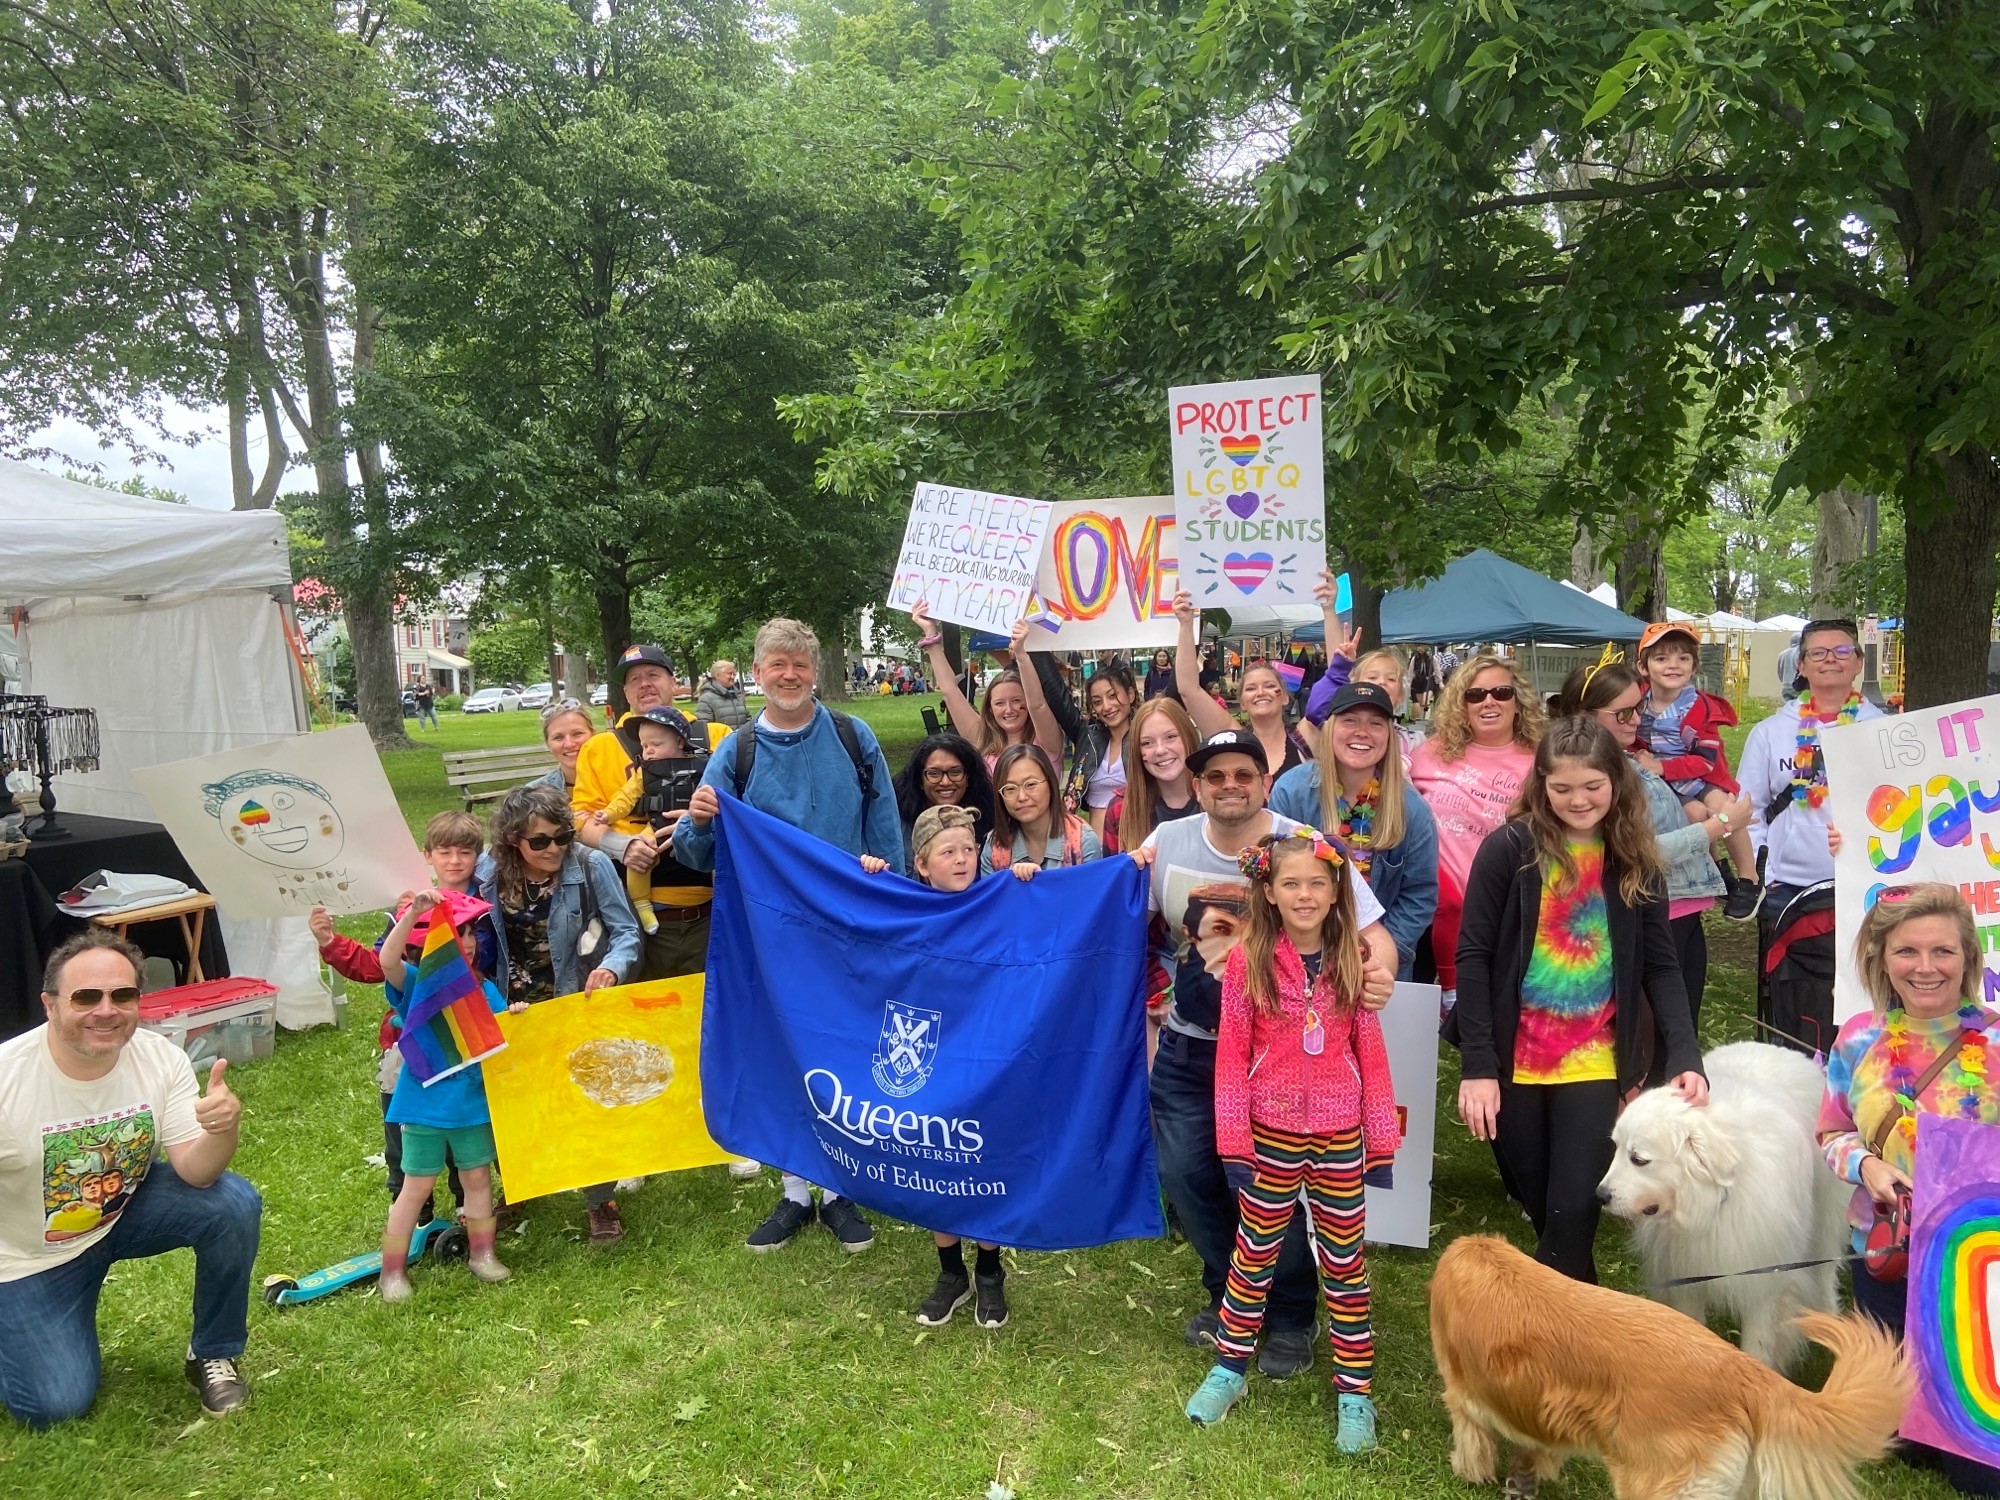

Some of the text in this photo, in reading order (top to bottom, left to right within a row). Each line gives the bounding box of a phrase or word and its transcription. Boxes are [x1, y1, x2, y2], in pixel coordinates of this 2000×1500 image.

[1177, 393, 1316, 435] PROTECT
[1186, 464, 1301, 497] LGBTQ
[915, 487, 1049, 537] WE'RE HERE
[1185, 518, 1325, 542] STUDENTS
[906, 521, 1032, 570] WE'RE QUEER
[901, 551, 926, 567] WE'LL
[942, 556, 997, 581] EDUCATING
[997, 566, 1019, 585] YOUR
[1016, 570, 1034, 587] KIDS
[1034, 510, 1199, 623] OVE
[890, 573, 1025, 630] NEXT YEAR!
[1877, 721, 1926, 770] IS
[1937, 707, 1985, 758] IT
[1435, 791, 1471, 813] GRATEFUL
[1488, 793, 1512, 806] Matt
[804, 1068, 983, 1152] Queen's
[880, 1140, 983, 1164] UNIVERSITY
[866, 1163, 887, 1183] of
[892, 1165, 1007, 1196] Education
